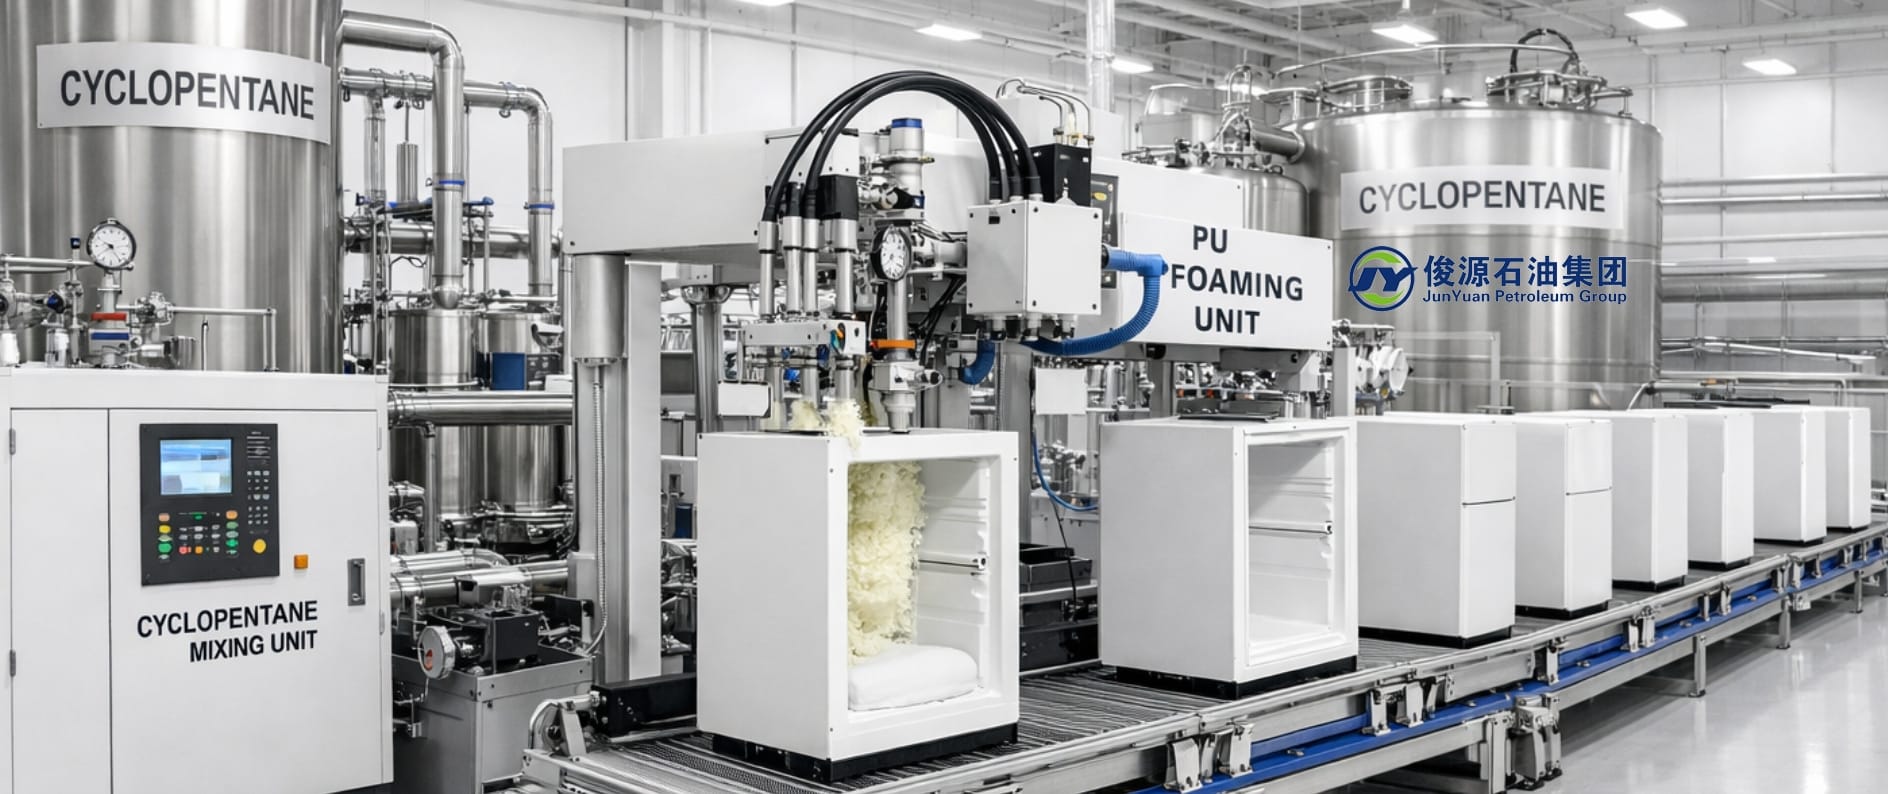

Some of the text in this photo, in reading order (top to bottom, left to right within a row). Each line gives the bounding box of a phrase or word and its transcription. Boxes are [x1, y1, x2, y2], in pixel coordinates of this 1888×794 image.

[60, 69, 315, 120] CYCLOPENTANE
[1359, 180, 1606, 214] CYCLOPENTANE
[1192, 225, 1228, 254] PU
[1171, 263, 1304, 301] FOAMING
[1194, 305, 1261, 335] UNIT
[136, 600, 318, 638] CYCLOPENTANE
[190, 630, 318, 662] MIXING UNIT
